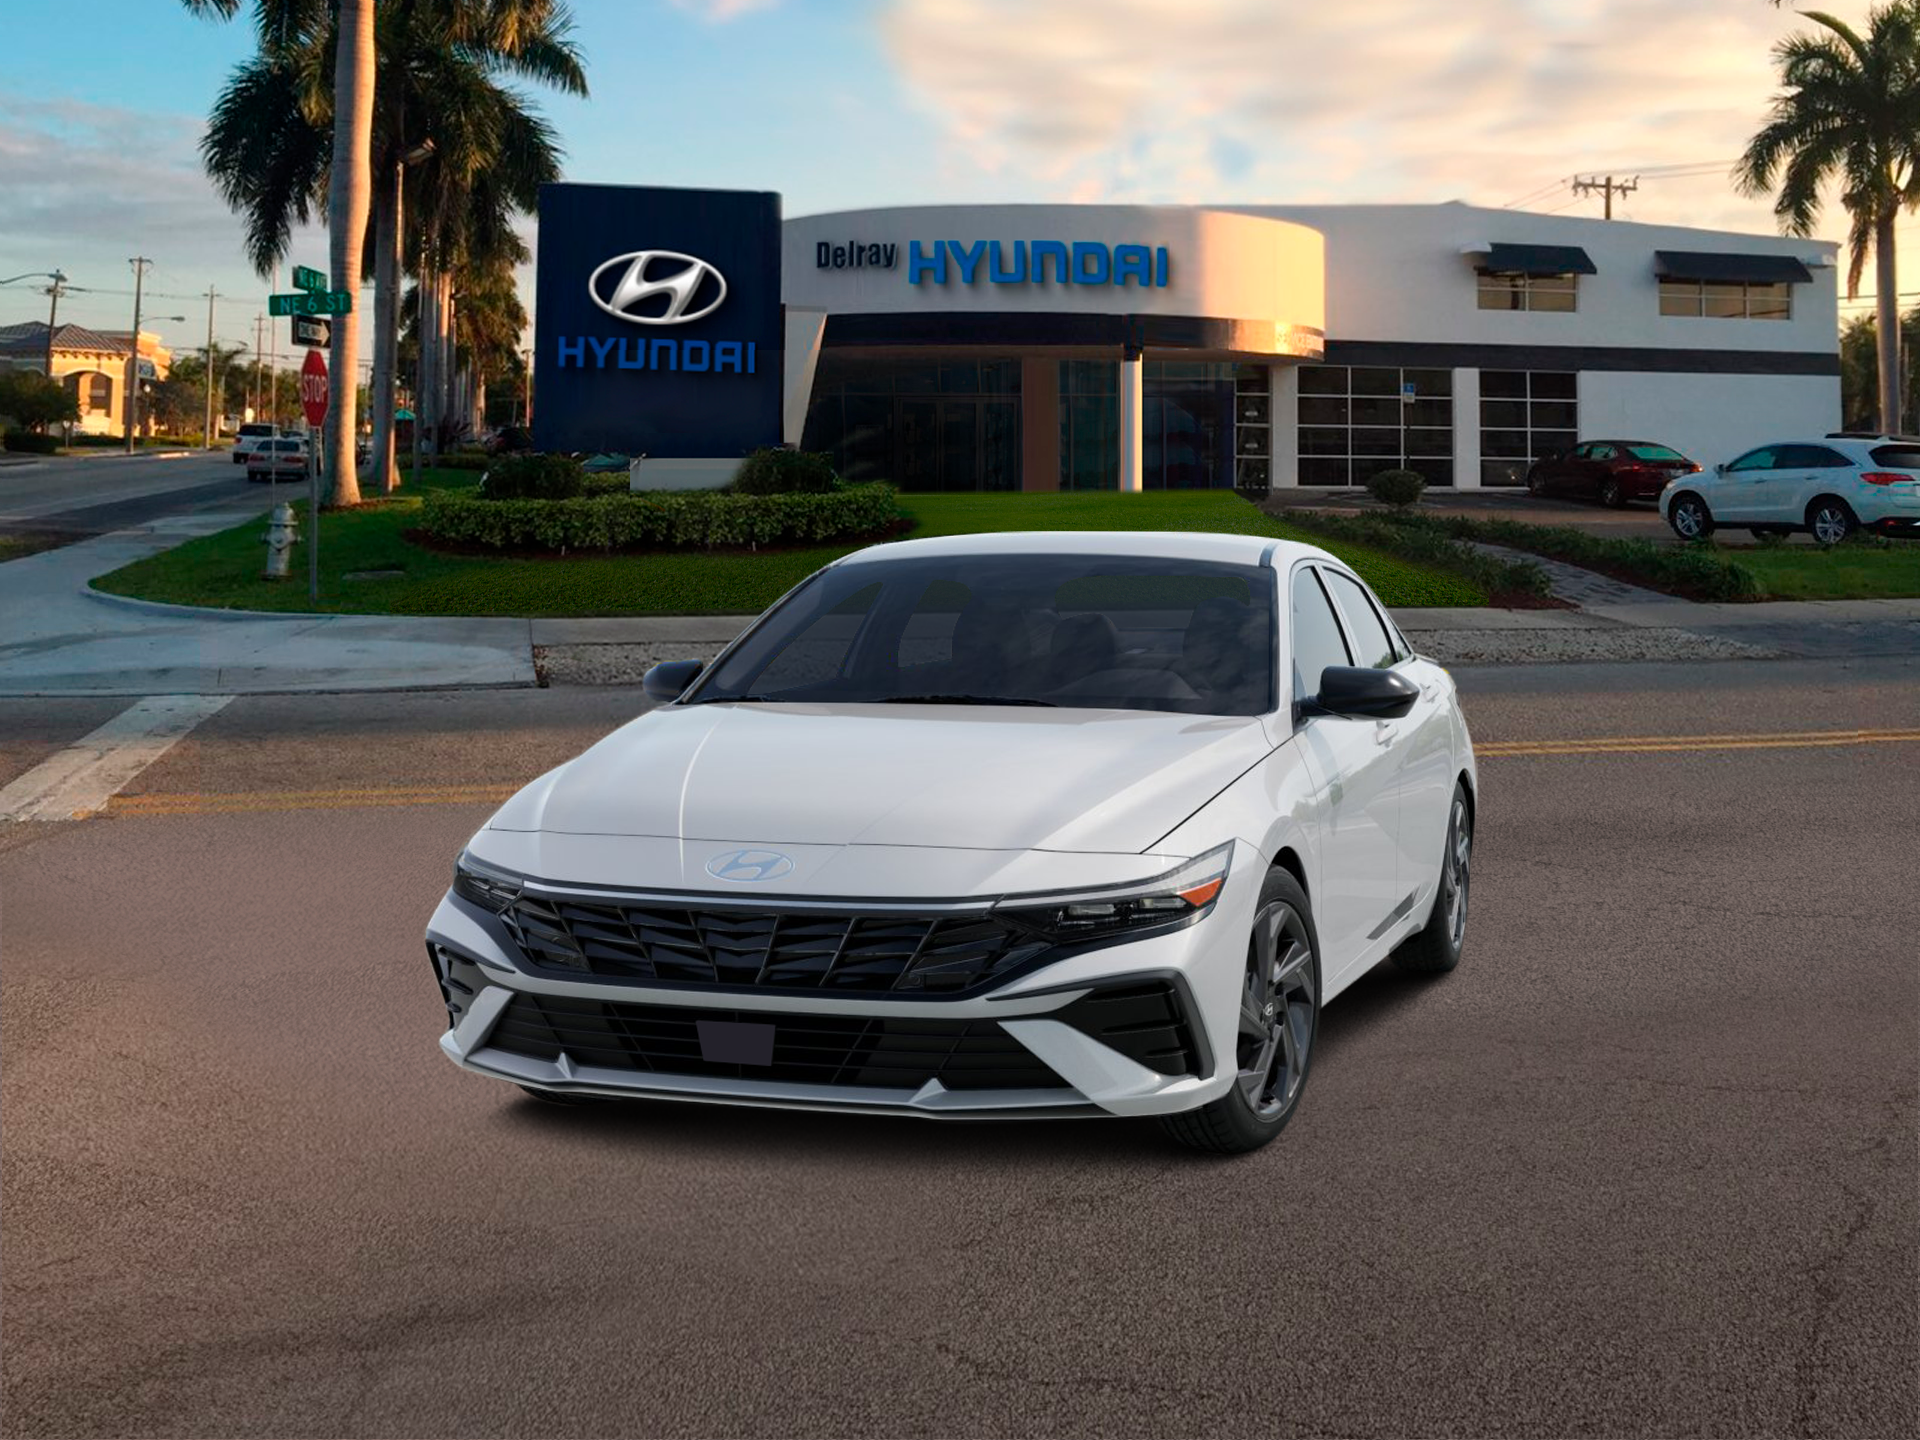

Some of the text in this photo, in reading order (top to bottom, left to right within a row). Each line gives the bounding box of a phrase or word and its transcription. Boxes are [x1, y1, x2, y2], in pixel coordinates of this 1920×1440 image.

[816, 240, 1168, 287] Delray HYUNDAI
[280, 294, 345, 314] NE 6 ST
[558, 336, 756, 374] HYUNDAI
[303, 374, 328, 402] STOP
